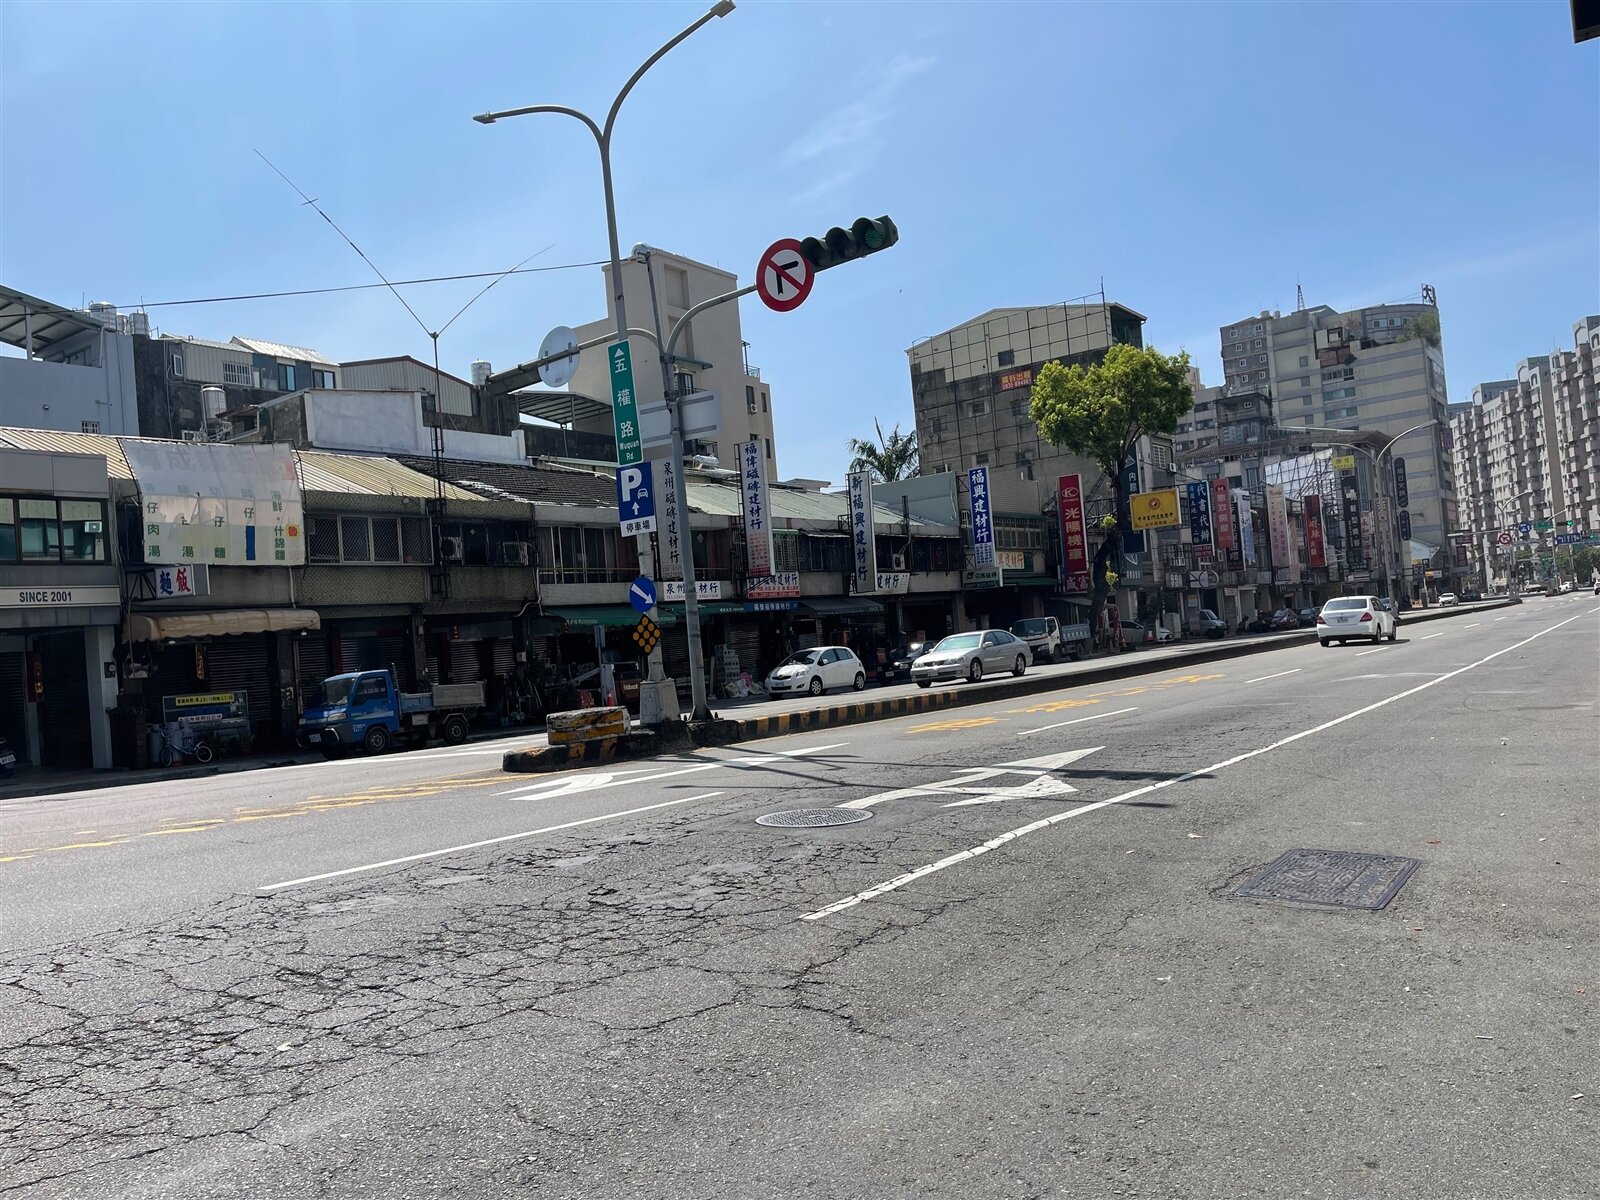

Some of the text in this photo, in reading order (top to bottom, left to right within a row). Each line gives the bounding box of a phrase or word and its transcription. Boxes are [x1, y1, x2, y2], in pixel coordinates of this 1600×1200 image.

[614, 358, 634, 438] 五權路
[619, 440, 641, 451] Wuquan
[626, 453, 635, 461] Rd
[620, 467, 644, 502] P
[744, 443, 763, 530] 福偉磁磚建材行
[626, 521, 650, 533] 停車場
[663, 462, 680, 564] 泉州磁磚建材行
[971, 471, 989, 543] 福興建材行
[851, 478, 868, 581] 新福興建材行
[1065, 507, 1083, 560] 光陽機車
[19, 591, 72, 604] SINCE 2001
[666, 582, 719, 595] 泉州材行
